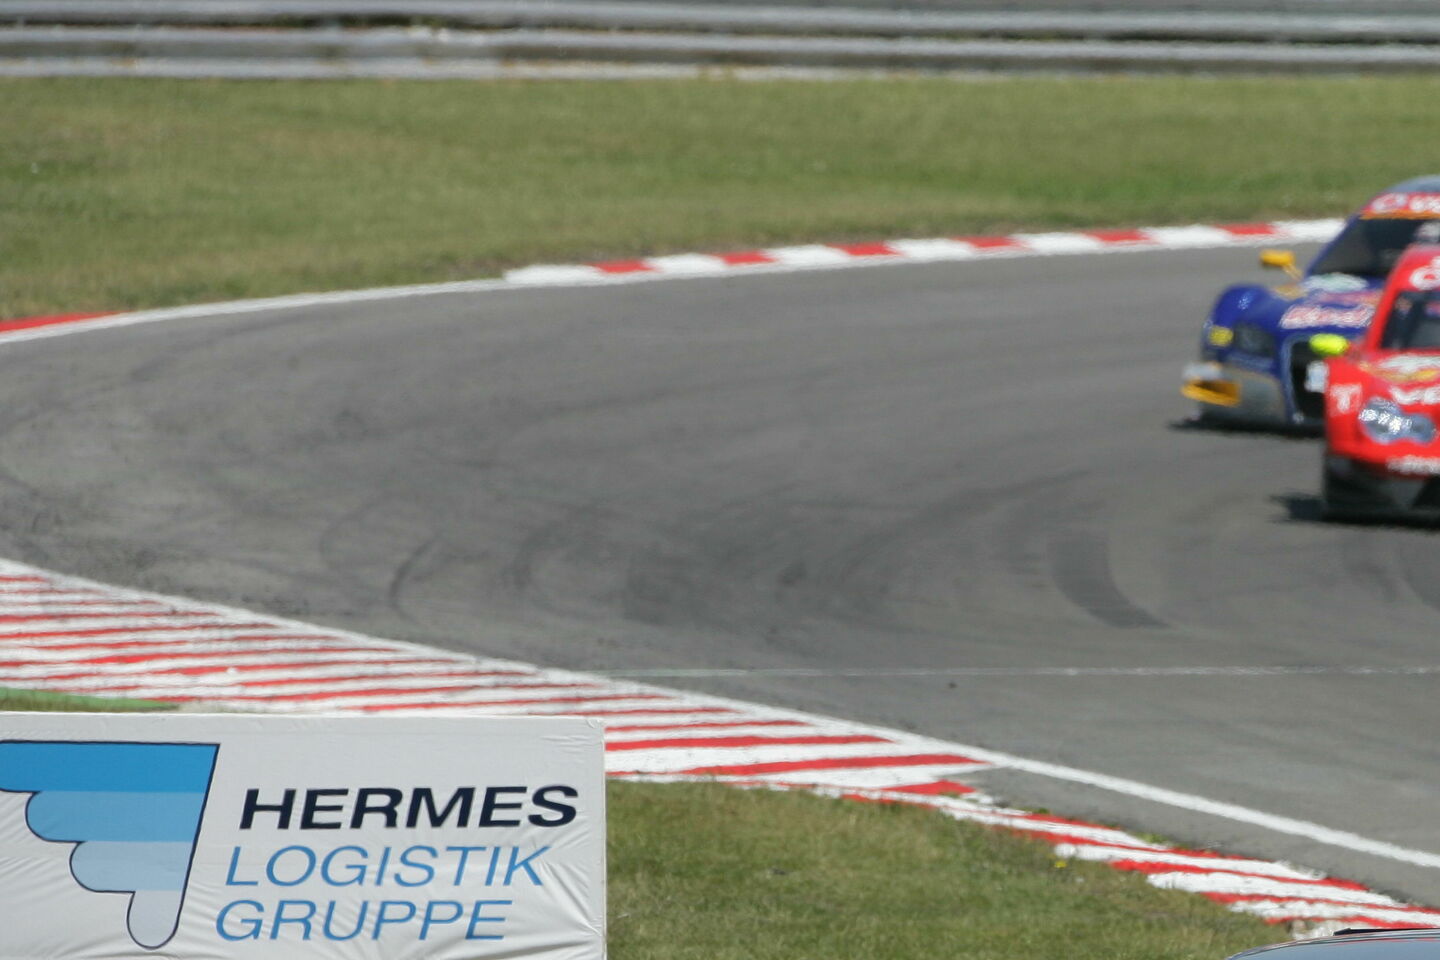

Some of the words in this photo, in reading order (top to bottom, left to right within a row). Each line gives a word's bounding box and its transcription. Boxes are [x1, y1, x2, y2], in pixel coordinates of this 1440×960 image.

[239, 784, 579, 830] HERMES
[225, 844, 552, 888] LOGISTIK
[215, 899, 513, 942] GRUPPE
